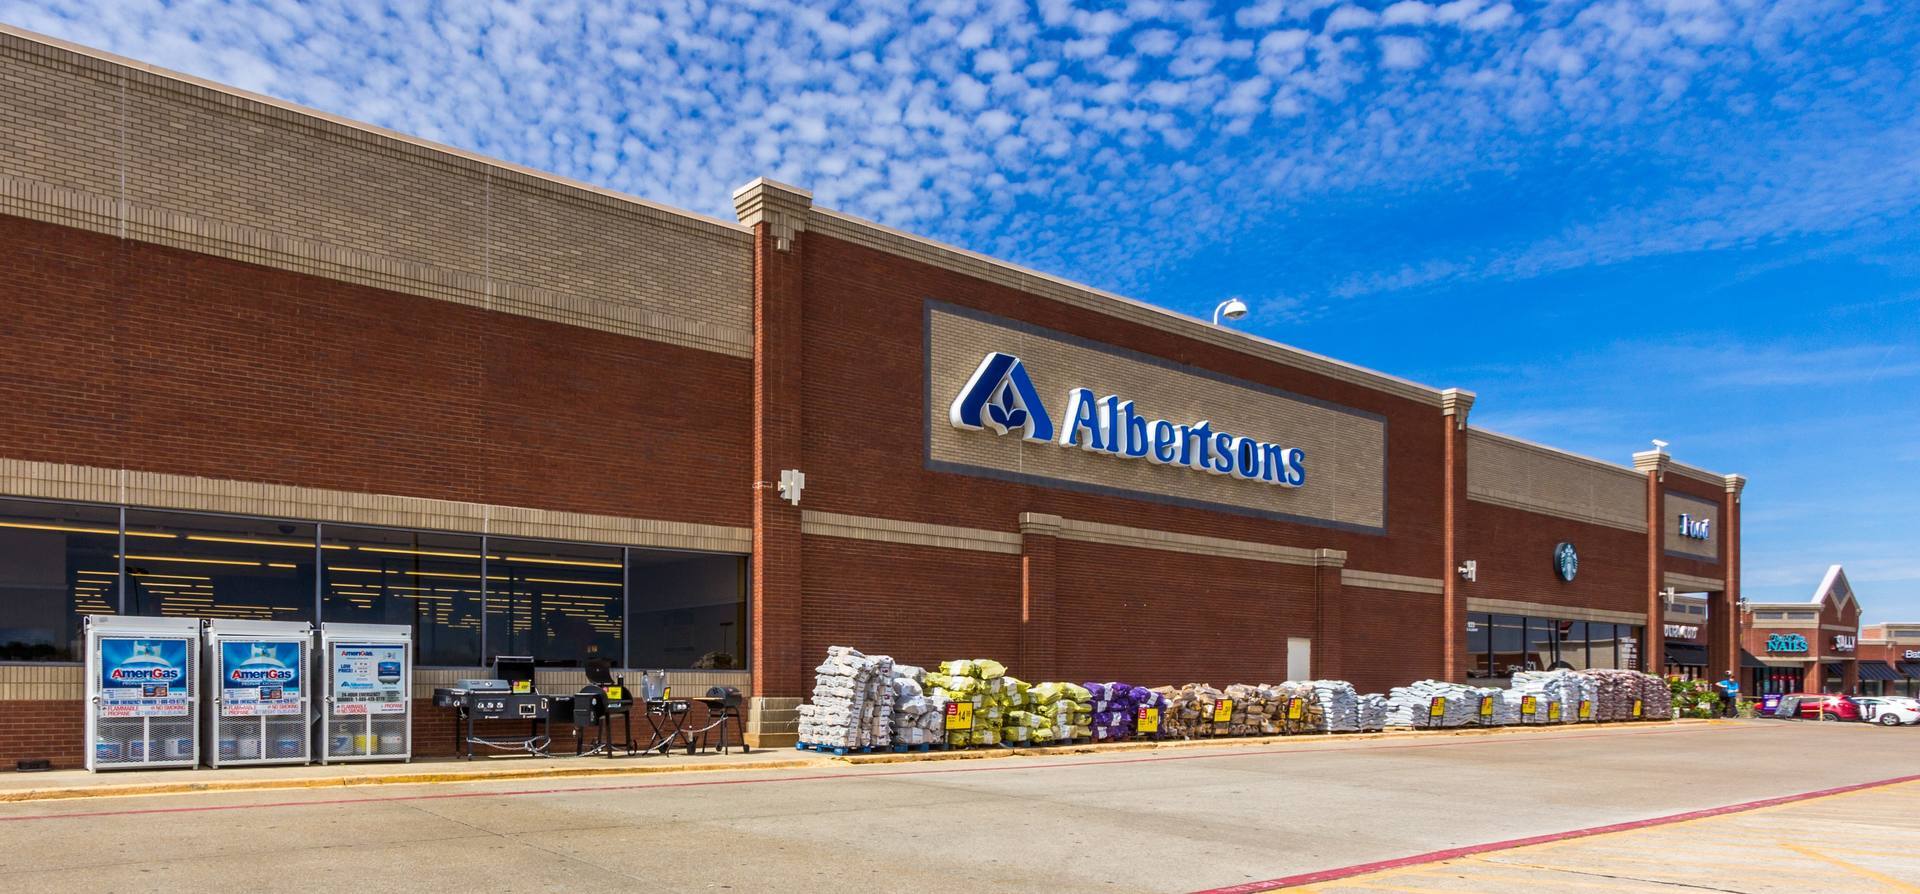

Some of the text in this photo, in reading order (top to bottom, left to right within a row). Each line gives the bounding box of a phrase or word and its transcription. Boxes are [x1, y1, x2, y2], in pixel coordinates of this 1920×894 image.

[1060, 388, 1305, 487] Albertsons
[1767, 640, 1808, 652] NAILS
[112, 668, 178, 679] AmeriGas
[231, 669, 292, 679] AmeriGas
